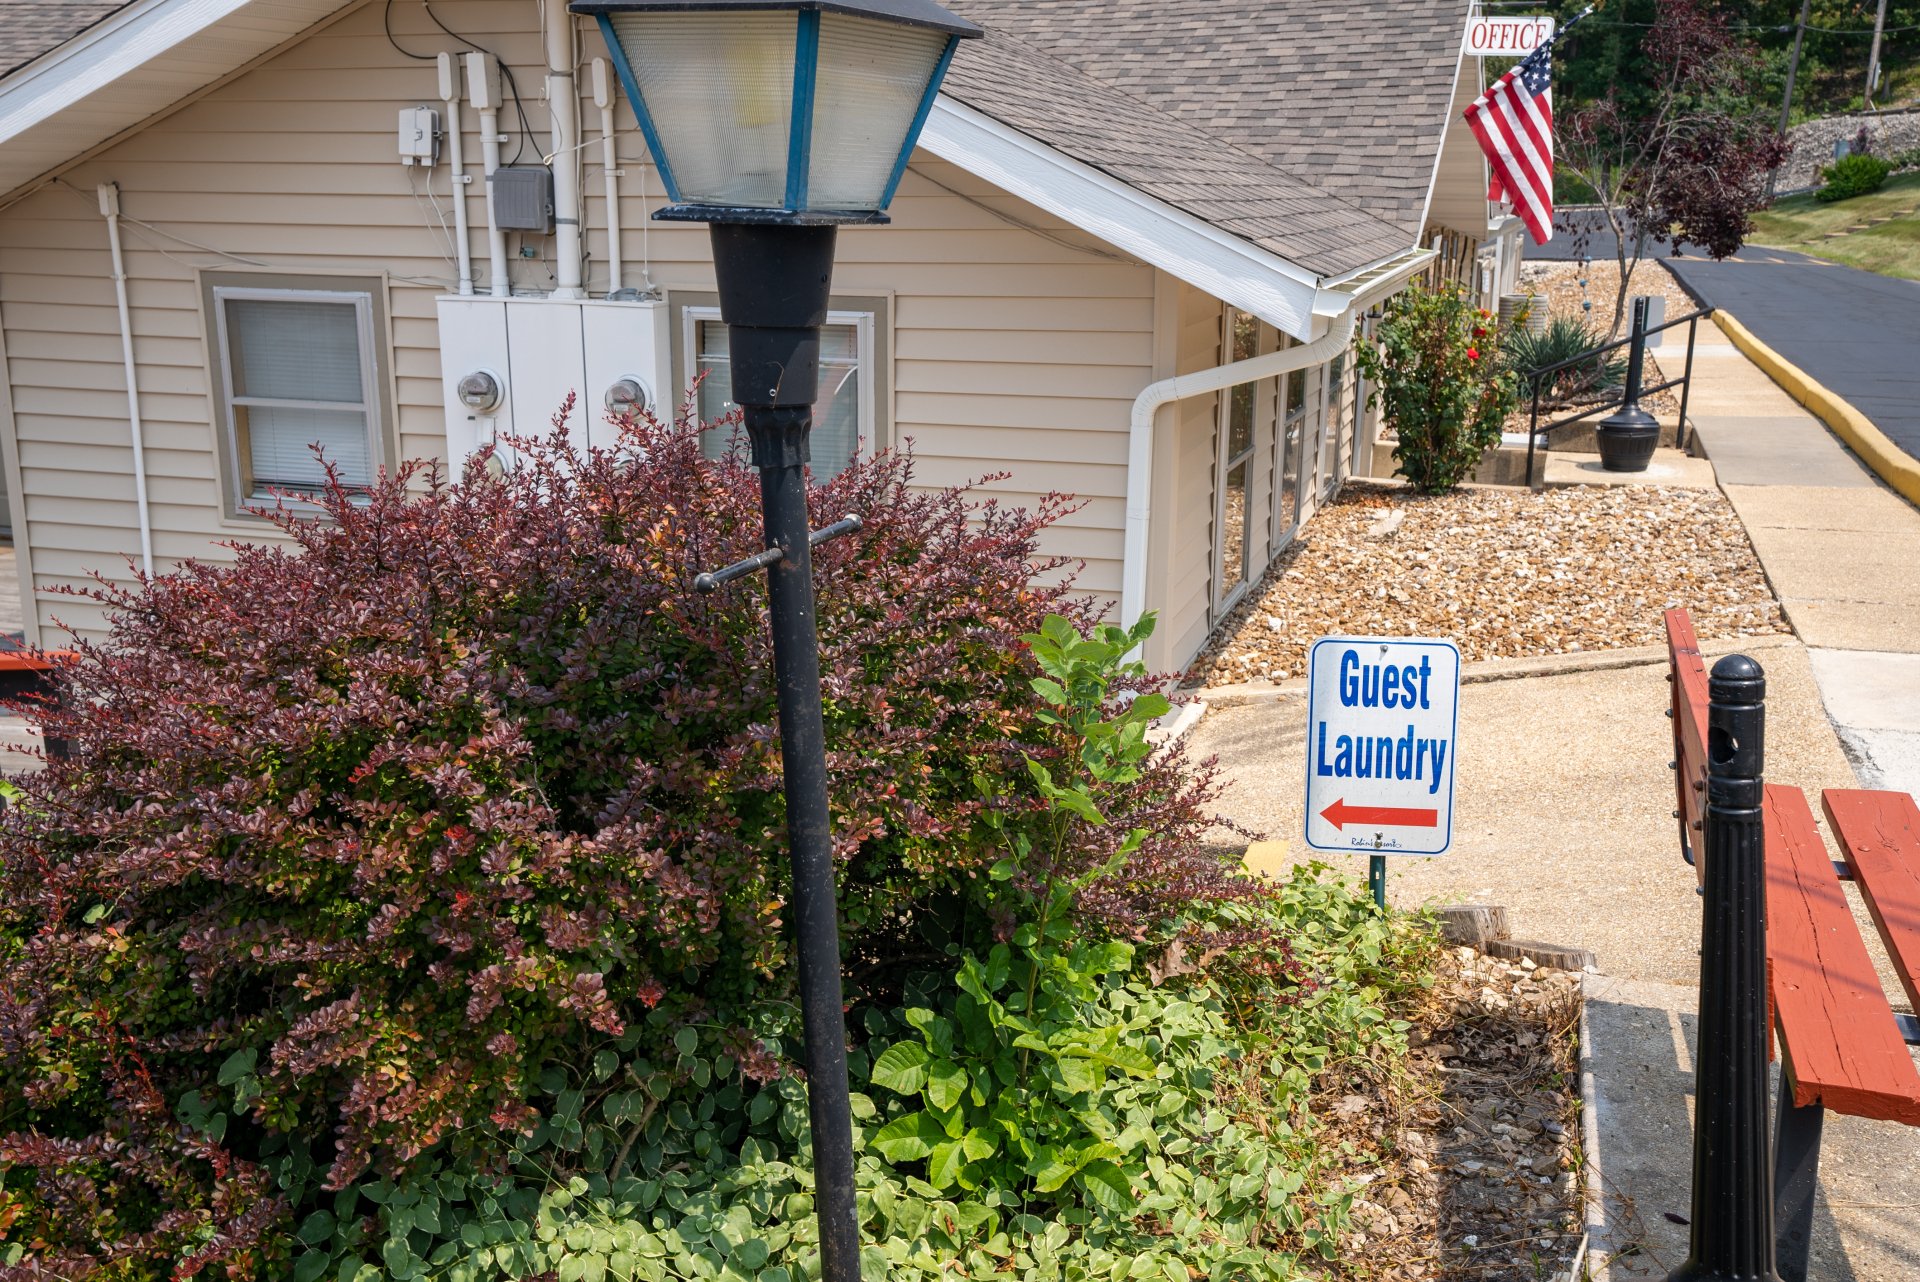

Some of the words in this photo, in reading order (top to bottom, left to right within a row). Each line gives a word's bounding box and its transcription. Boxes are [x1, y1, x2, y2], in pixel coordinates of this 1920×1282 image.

[1471, 23, 1546, 49] OFFICE
[1339, 649, 1432, 710] Guest
[1317, 721, 1448, 795] Laundry
